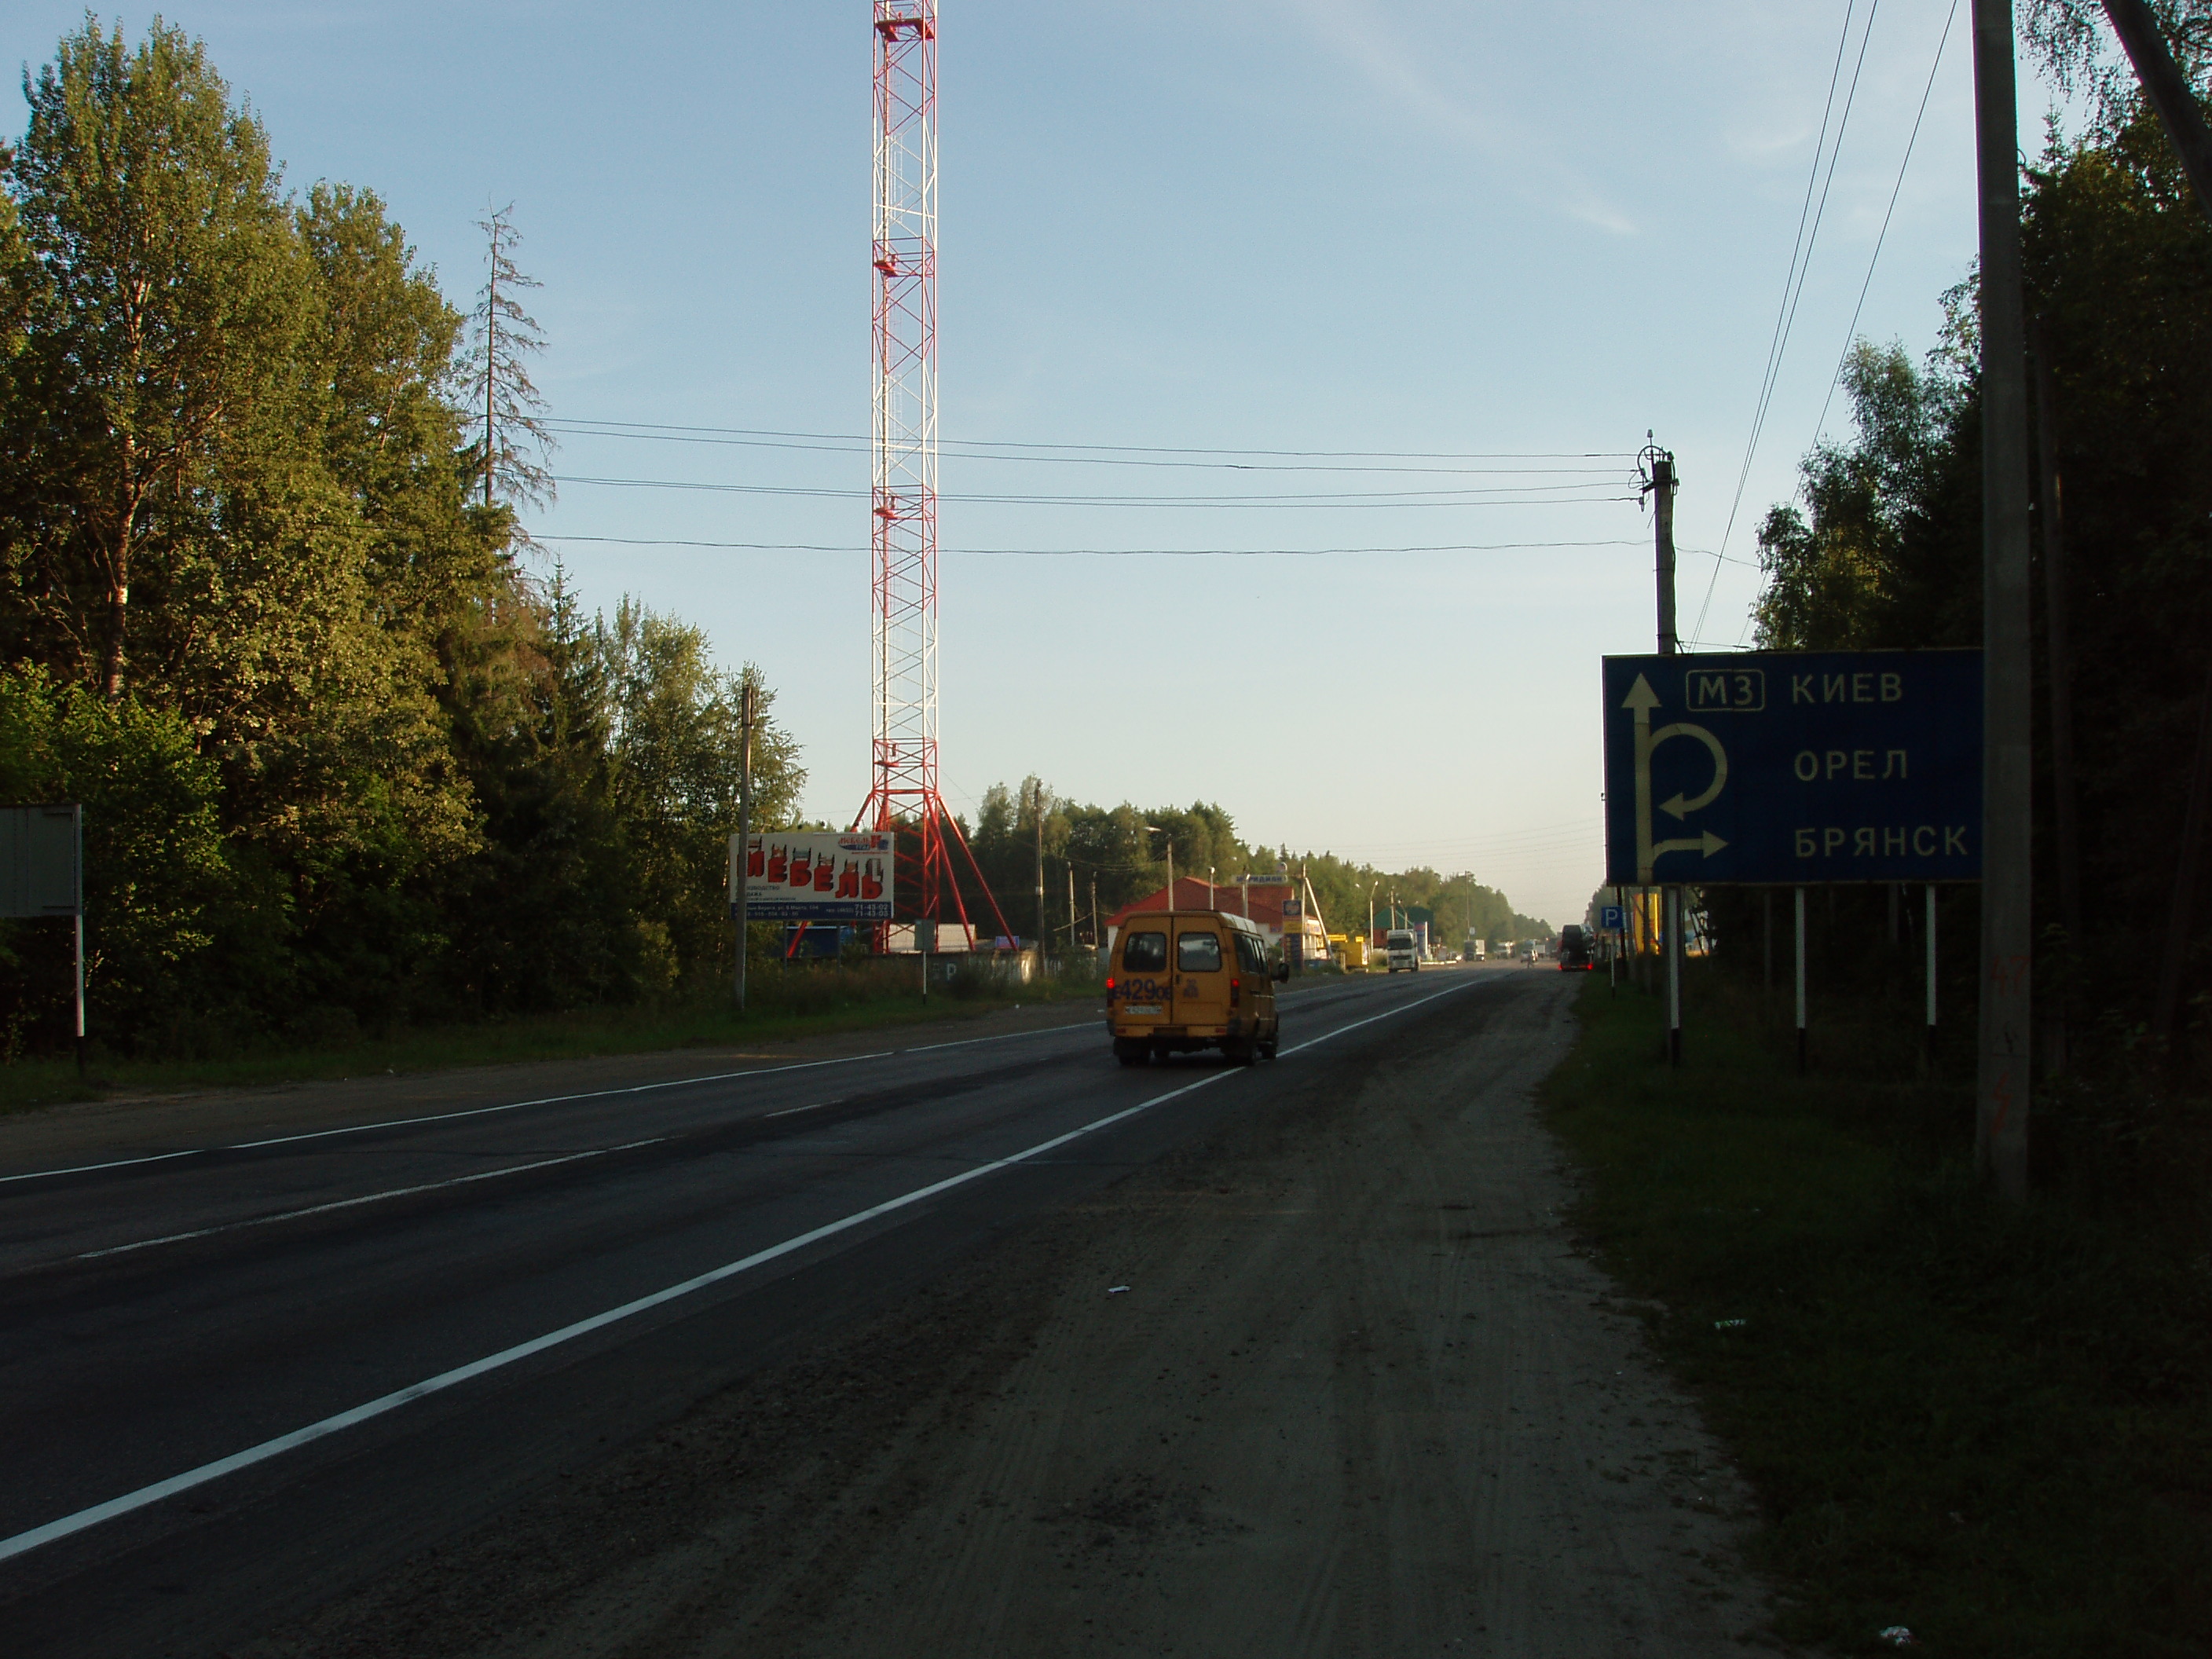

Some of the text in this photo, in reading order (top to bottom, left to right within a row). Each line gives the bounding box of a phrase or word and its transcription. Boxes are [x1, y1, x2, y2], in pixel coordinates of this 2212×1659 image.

[1697, 672, 1903, 706] М3 КИЕВ
[1793, 749, 1908, 782] ОРЕЛ
[1794, 825, 1968, 858] БРЯНСК
